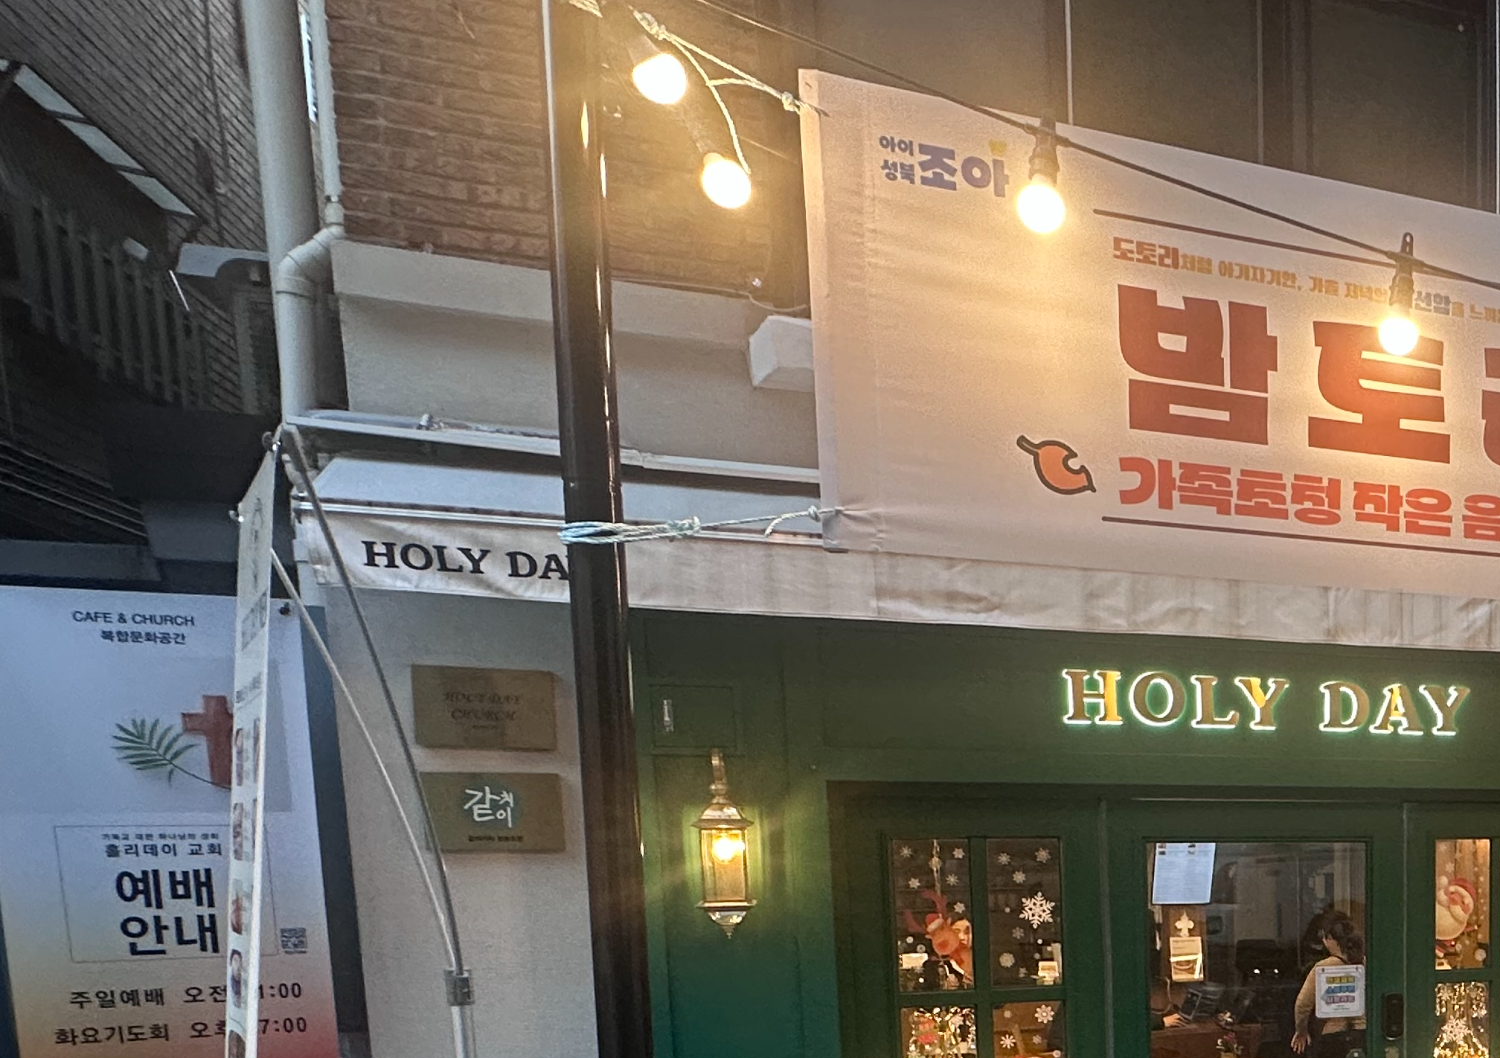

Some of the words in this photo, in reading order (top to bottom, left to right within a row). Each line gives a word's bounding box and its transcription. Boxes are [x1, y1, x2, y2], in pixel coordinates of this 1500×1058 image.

[878, 135, 914, 157] 아이
[880, 158, 916, 185] 성북
[918, 143, 1010, 198] 조아
[1118, 457, 1343, 526] 가족초청
[1353, 481, 1453, 537] 작은
[361, 540, 491, 576] HOLY
[504, 550, 570, 582] DA
[72, 610, 113, 625] CAFE
[117, 612, 127, 624] &
[131, 612, 195, 628] CHURCH
[100, 630, 187, 646] 복합문화공간
[1061, 668, 1291, 732] HOLY
[1318, 679, 1471, 737] DAY
[105, 842, 178, 858] 홀리데이
[187, 842, 223, 856] 교회
[115, 867, 217, 910] 예배
[120, 911, 221, 957] 안내
[69, 987, 166, 1010] 주일예배
[54, 1022, 170, 1046] 화요기도회
